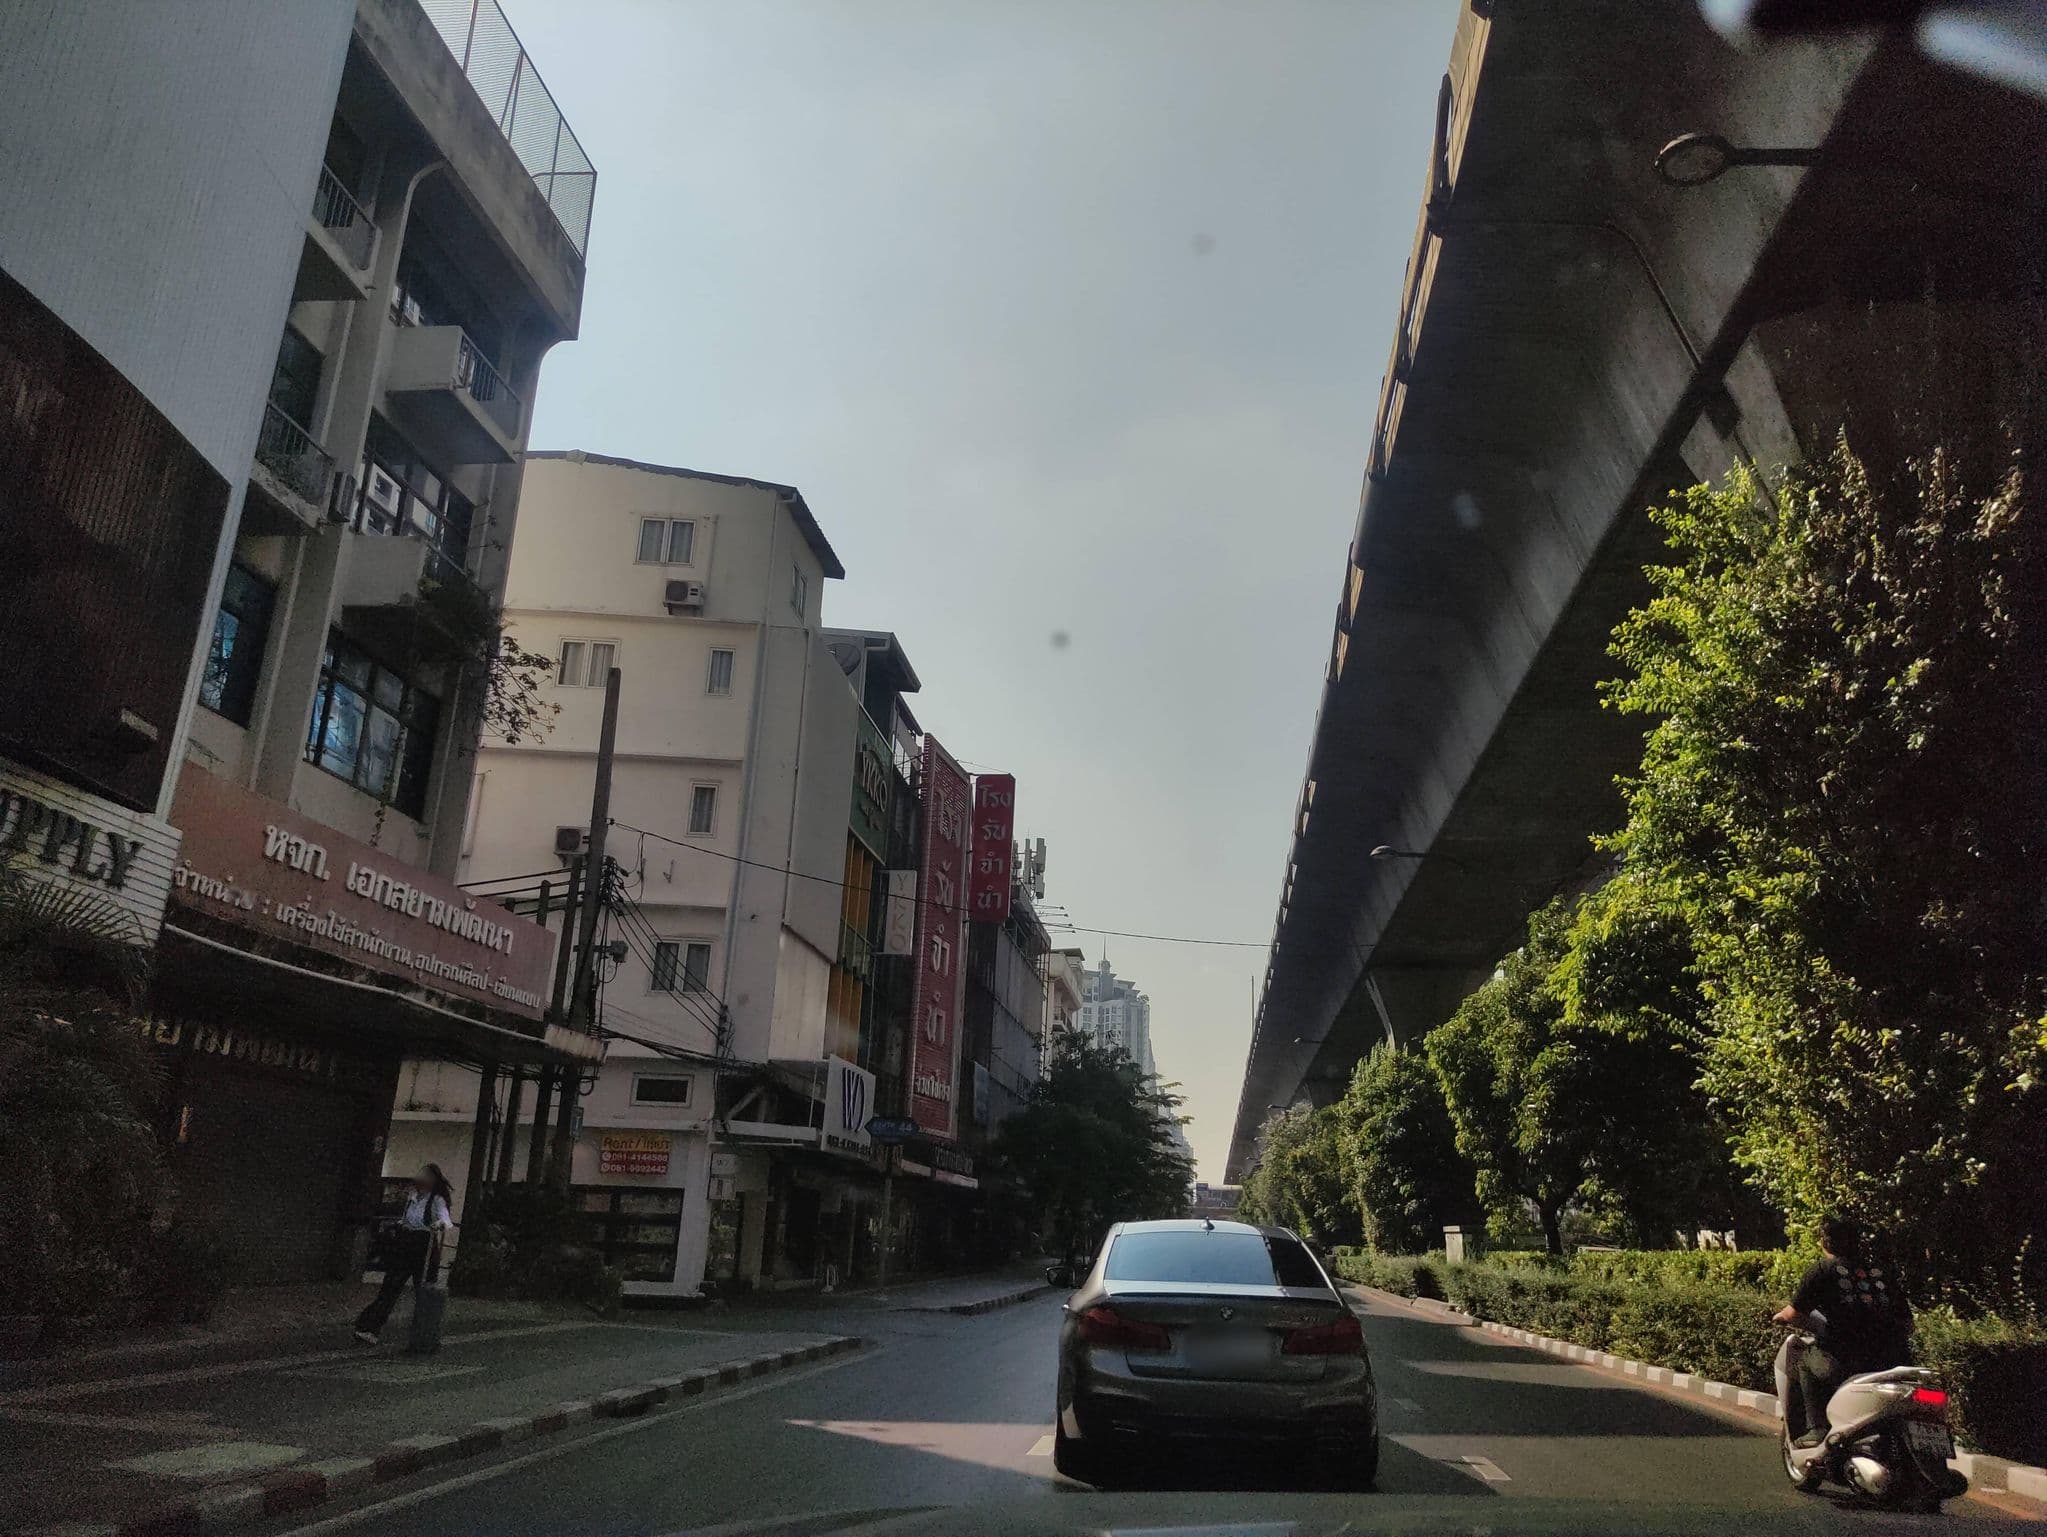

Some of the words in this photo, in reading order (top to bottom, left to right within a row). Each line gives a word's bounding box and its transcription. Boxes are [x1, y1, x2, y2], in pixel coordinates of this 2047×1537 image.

[861, 752, 888, 813] YKKO
[263, 824, 330, 881] หจก.
[346, 861, 514, 956] เอกสยามพัฒนา
